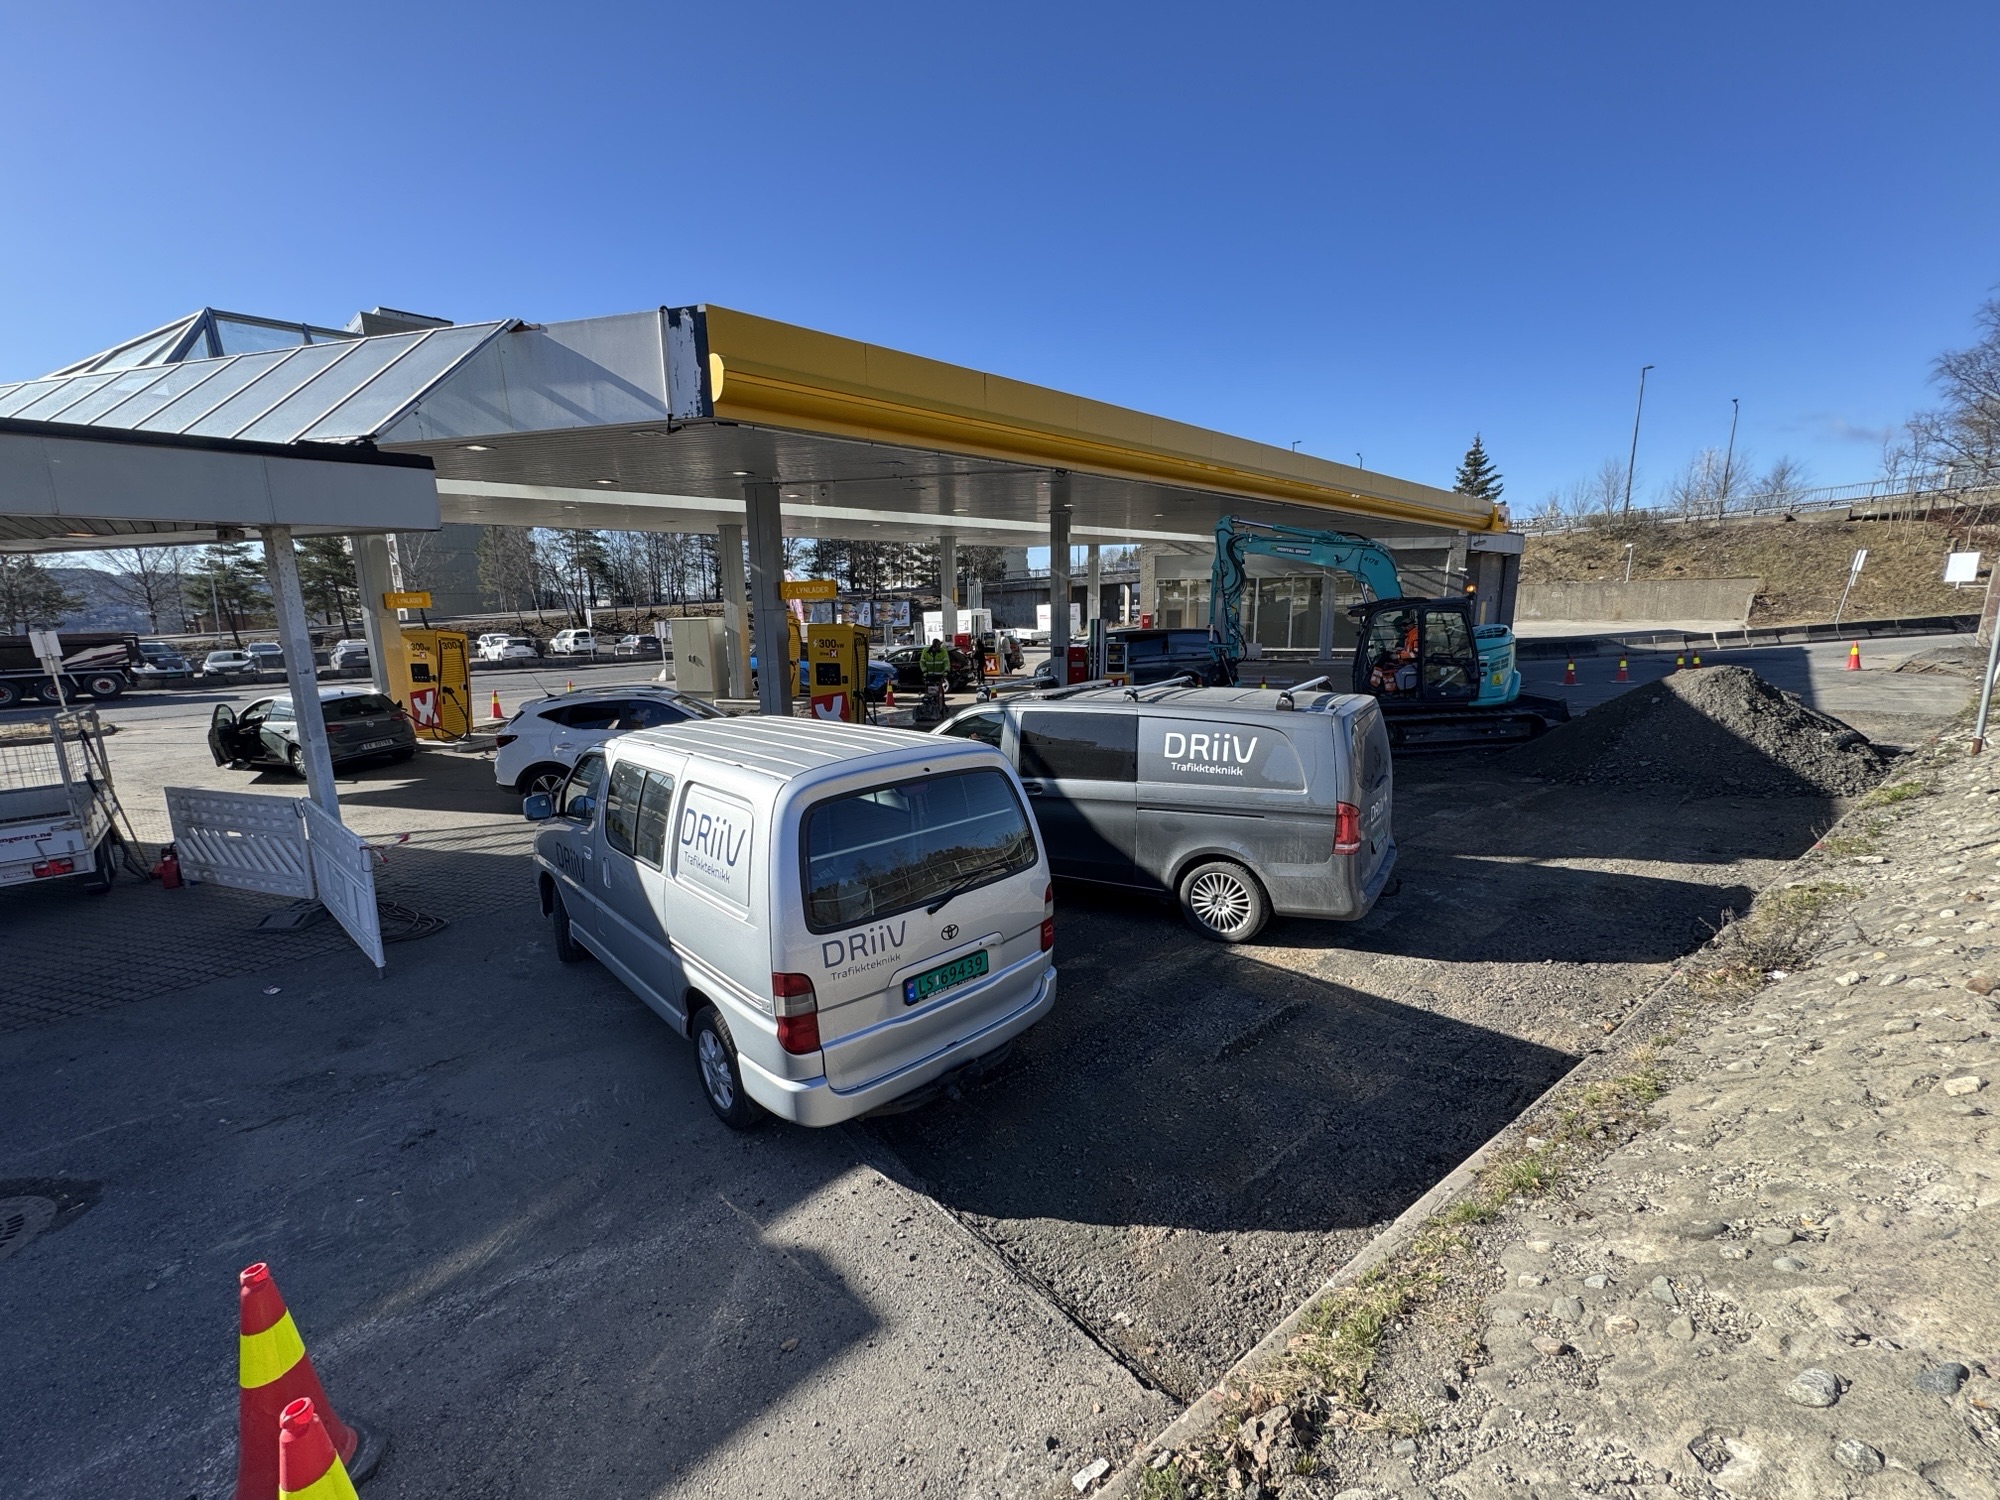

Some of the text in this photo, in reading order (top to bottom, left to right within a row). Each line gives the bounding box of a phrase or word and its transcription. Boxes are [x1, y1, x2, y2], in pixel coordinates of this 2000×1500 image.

[796, 586, 829, 594] LYNLADER
[411, 643, 425, 651] 300
[441, 641, 458, 650] 300
[818, 639, 837, 649] 300
[1163, 732, 1258, 764] DRiiV
[1170, 762, 1244, 776] Trafikkteknikk
[681, 807, 746, 867] DRiiV
[555, 841, 585, 883] DRiiV
[684, 850, 731, 884] Trafikkteknikk
[821, 920, 906, 969] DRiiV
[830, 953, 901, 981] Trafikkteknikk
[918, 975, 934, 995] LS
[940, 956, 983, 985] 69439
